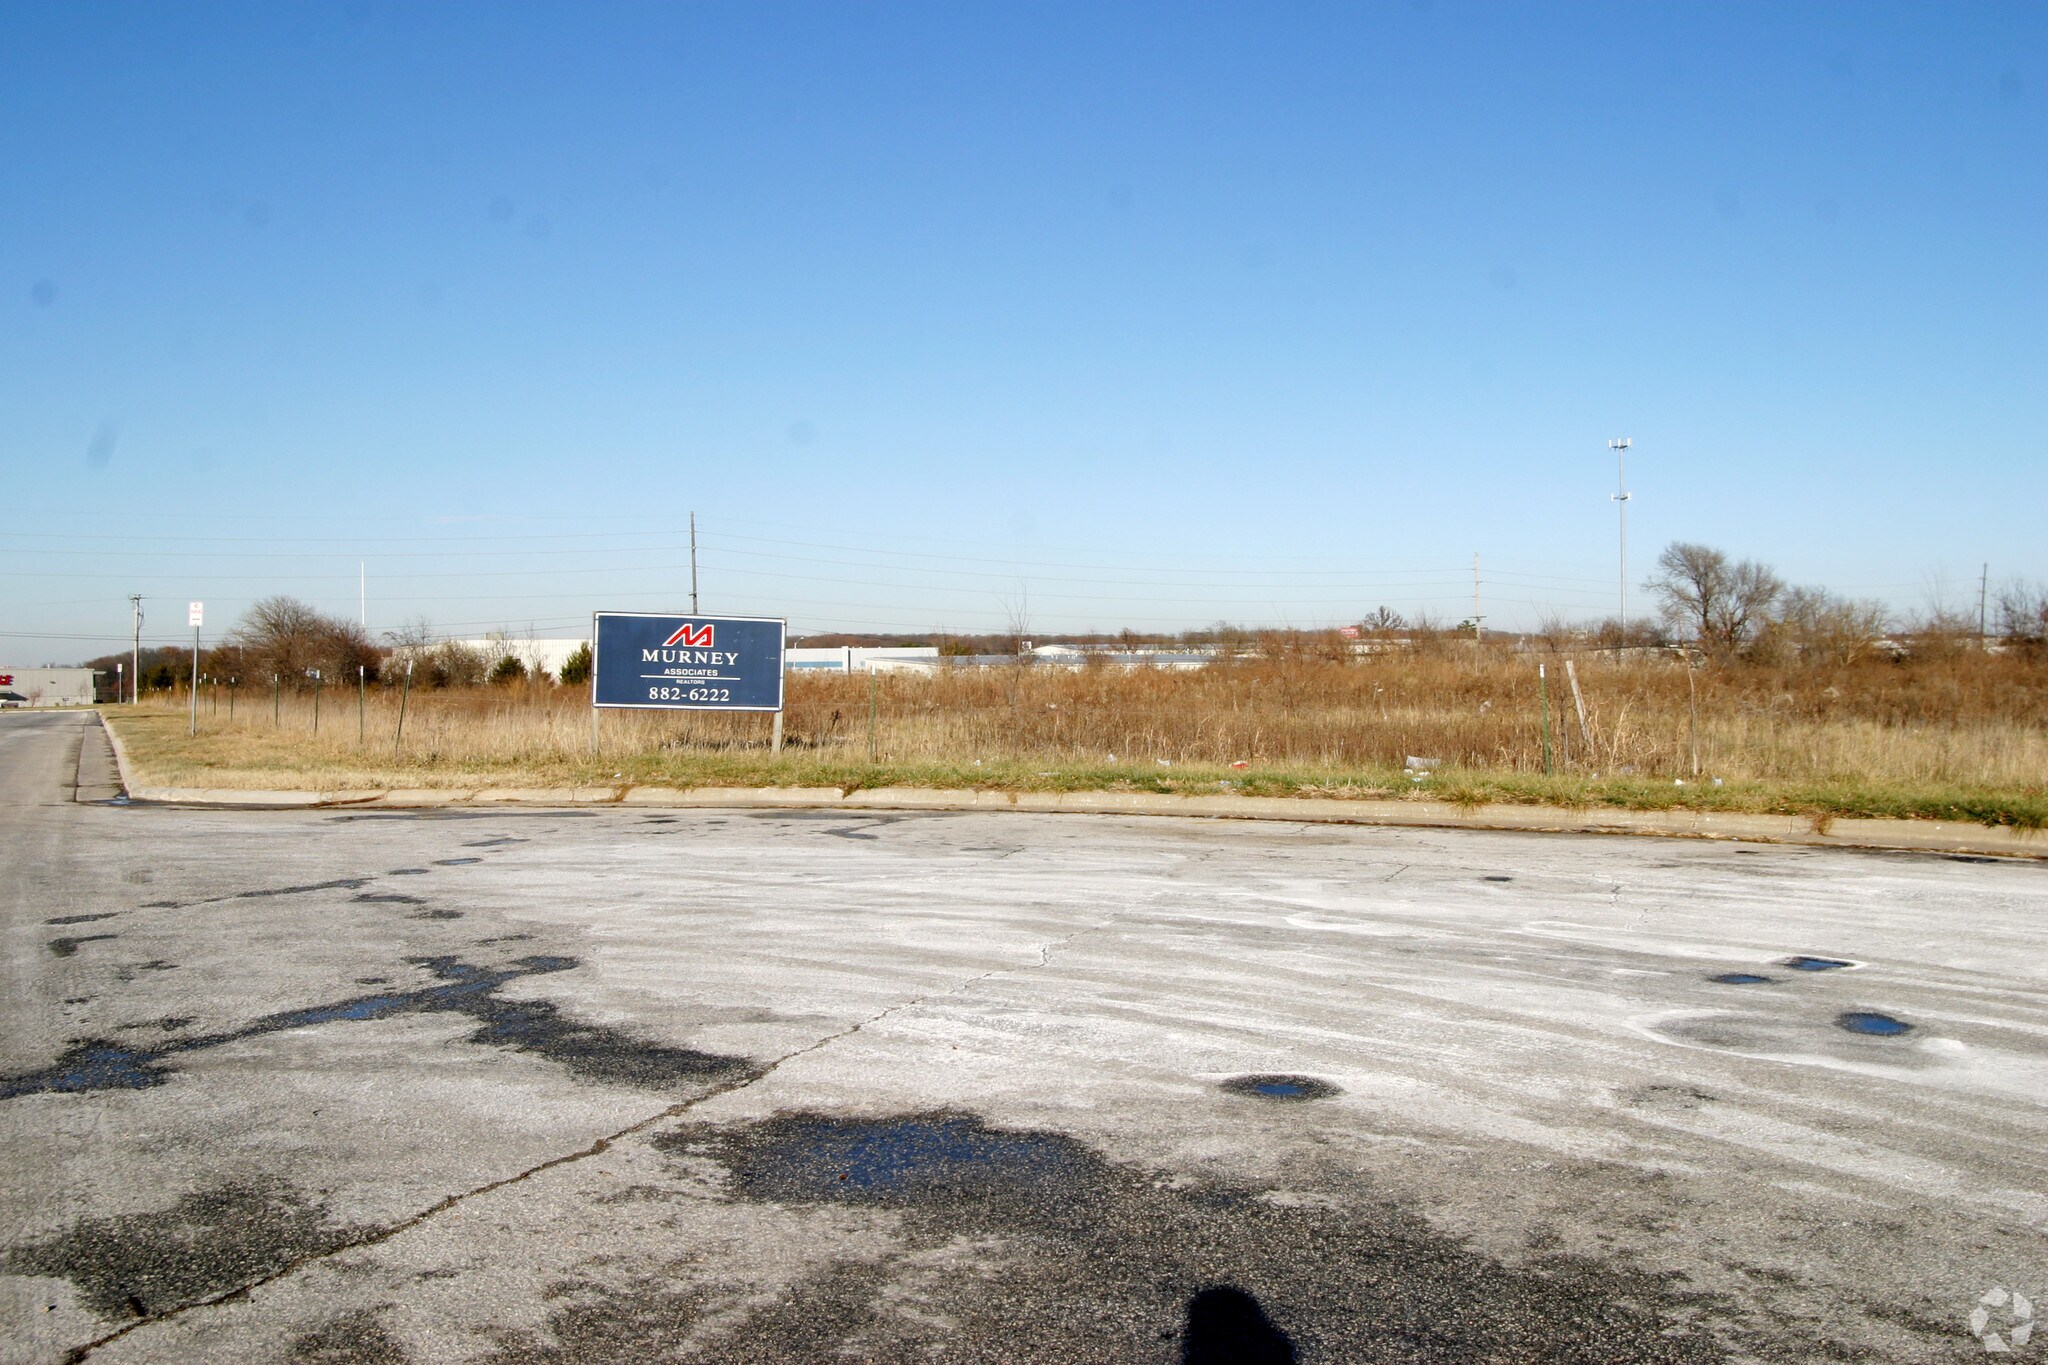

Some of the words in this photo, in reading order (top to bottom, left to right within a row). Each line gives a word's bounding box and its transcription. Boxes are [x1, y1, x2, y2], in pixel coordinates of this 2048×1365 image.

[641, 648, 739, 666] MURNEY
[663, 668, 719, 677] ASSOCIATES
[648, 686, 730, 702] 882-6222
